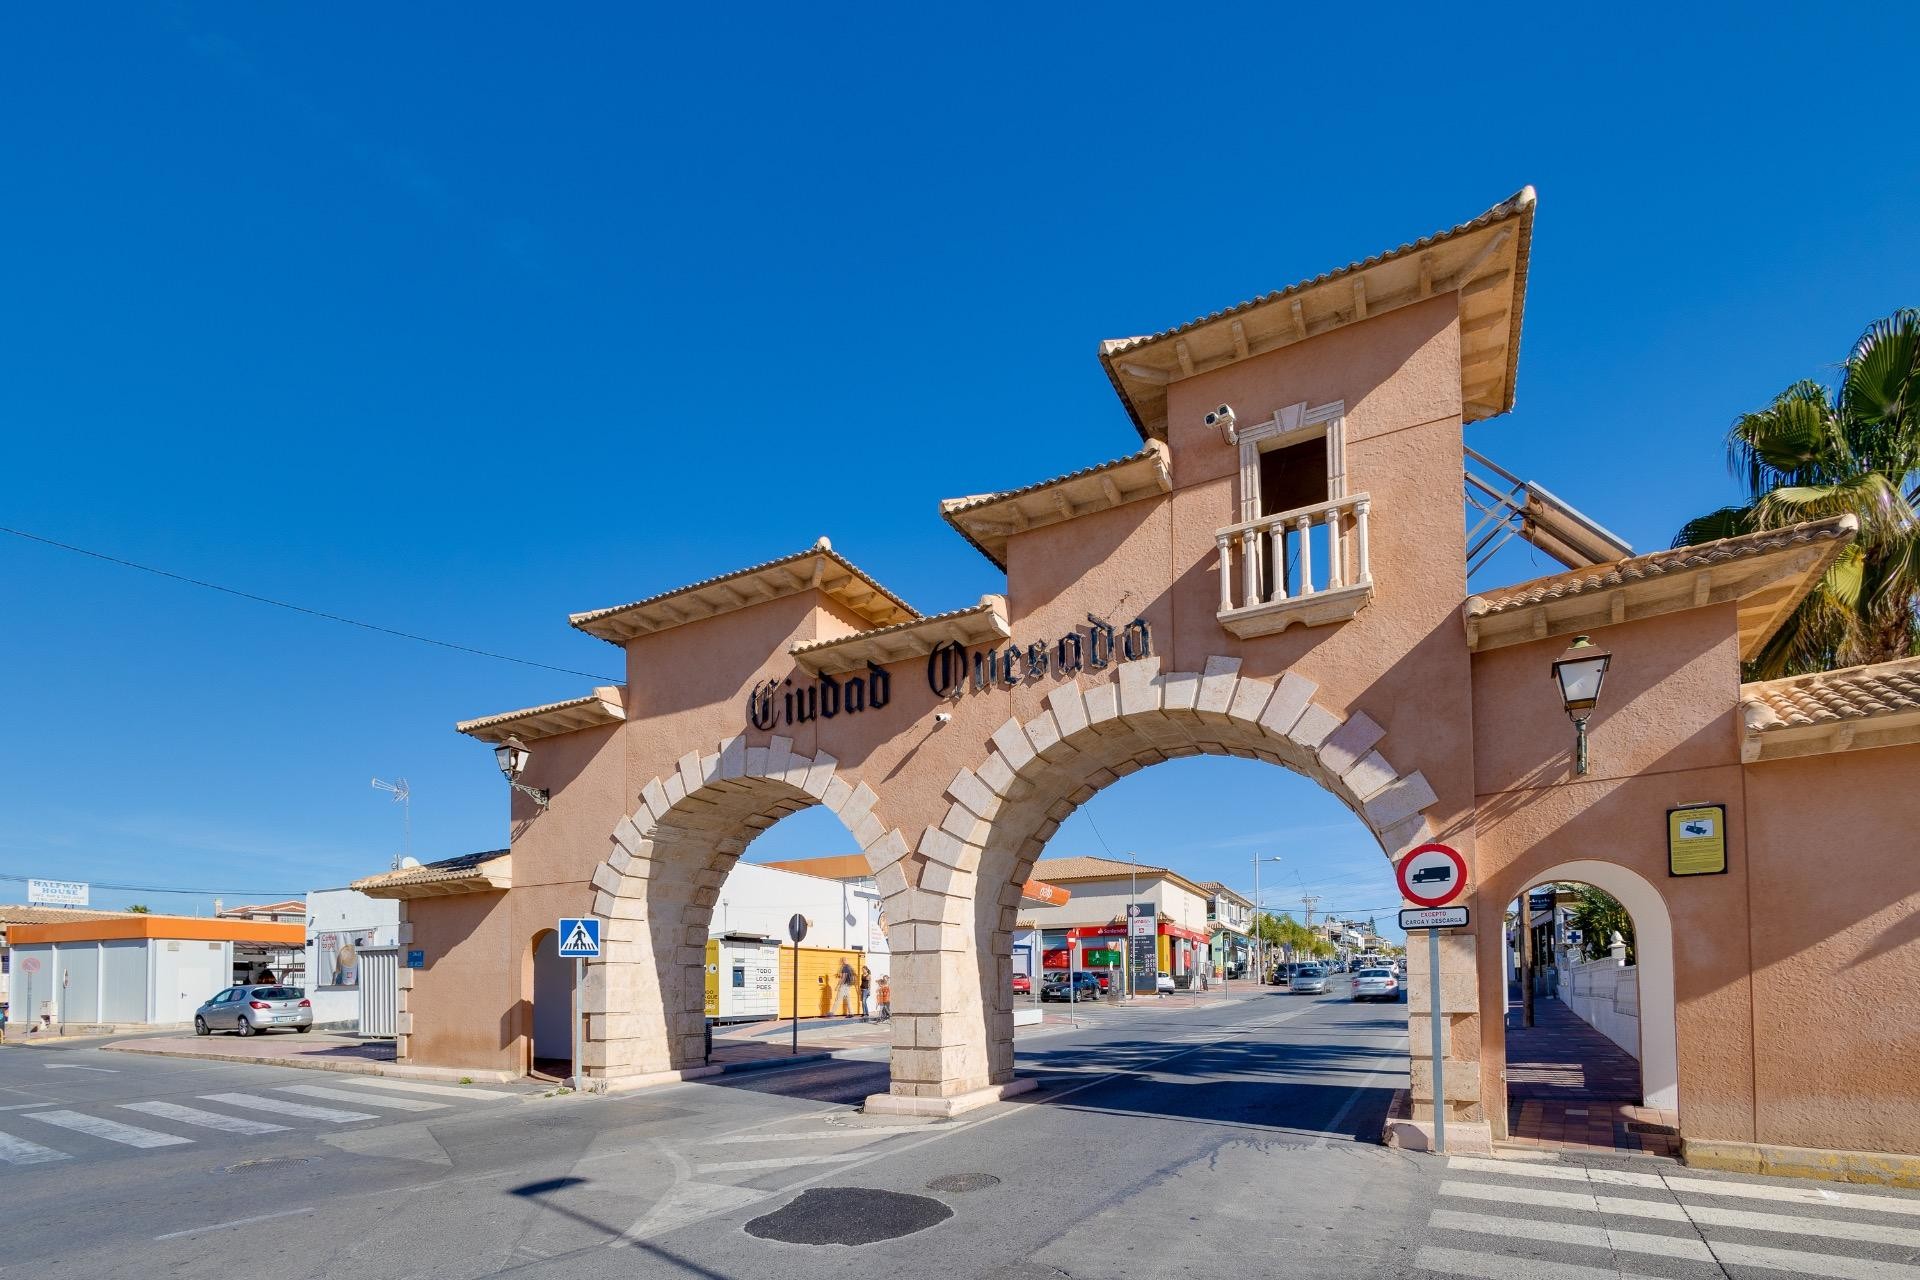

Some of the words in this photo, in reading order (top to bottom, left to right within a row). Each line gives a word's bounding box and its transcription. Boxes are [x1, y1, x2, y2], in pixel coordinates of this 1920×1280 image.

[751, 660, 891, 731] Ciudad
[928, 612, 1152, 700] Quesada
[33, 881, 83, 889] HALFWAY
